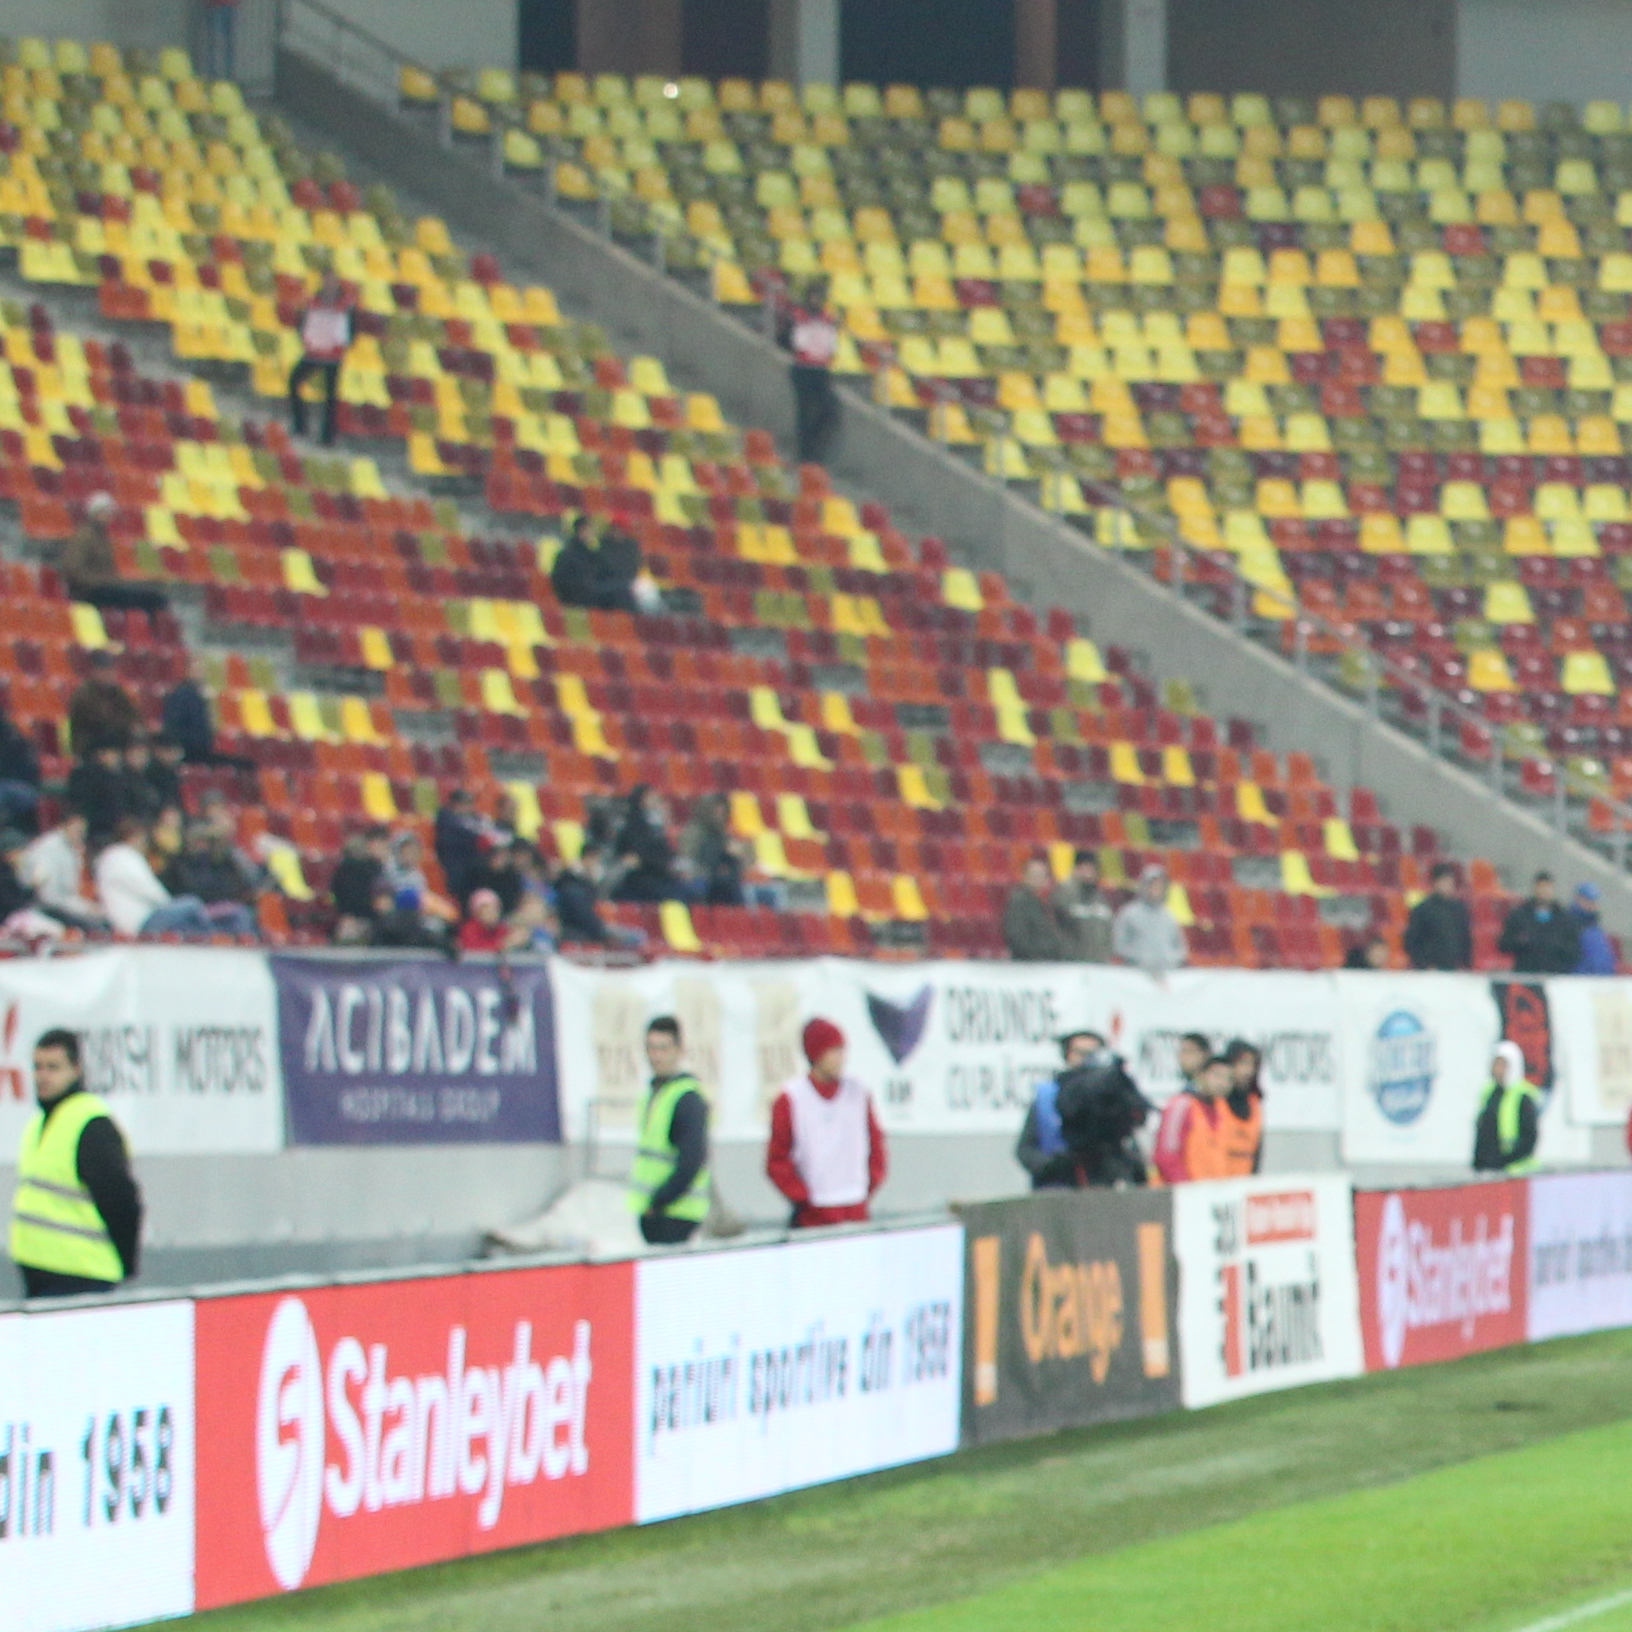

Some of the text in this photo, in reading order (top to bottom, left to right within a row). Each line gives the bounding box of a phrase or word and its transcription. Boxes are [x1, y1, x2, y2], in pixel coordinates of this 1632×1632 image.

[304, 985, 538, 1076] ACIBADEM
[1020, 1232, 1124, 1385] Orange
[79, 1404, 175, 1529] 1958
[324, 1319, 592, 1531] Stanleybet
